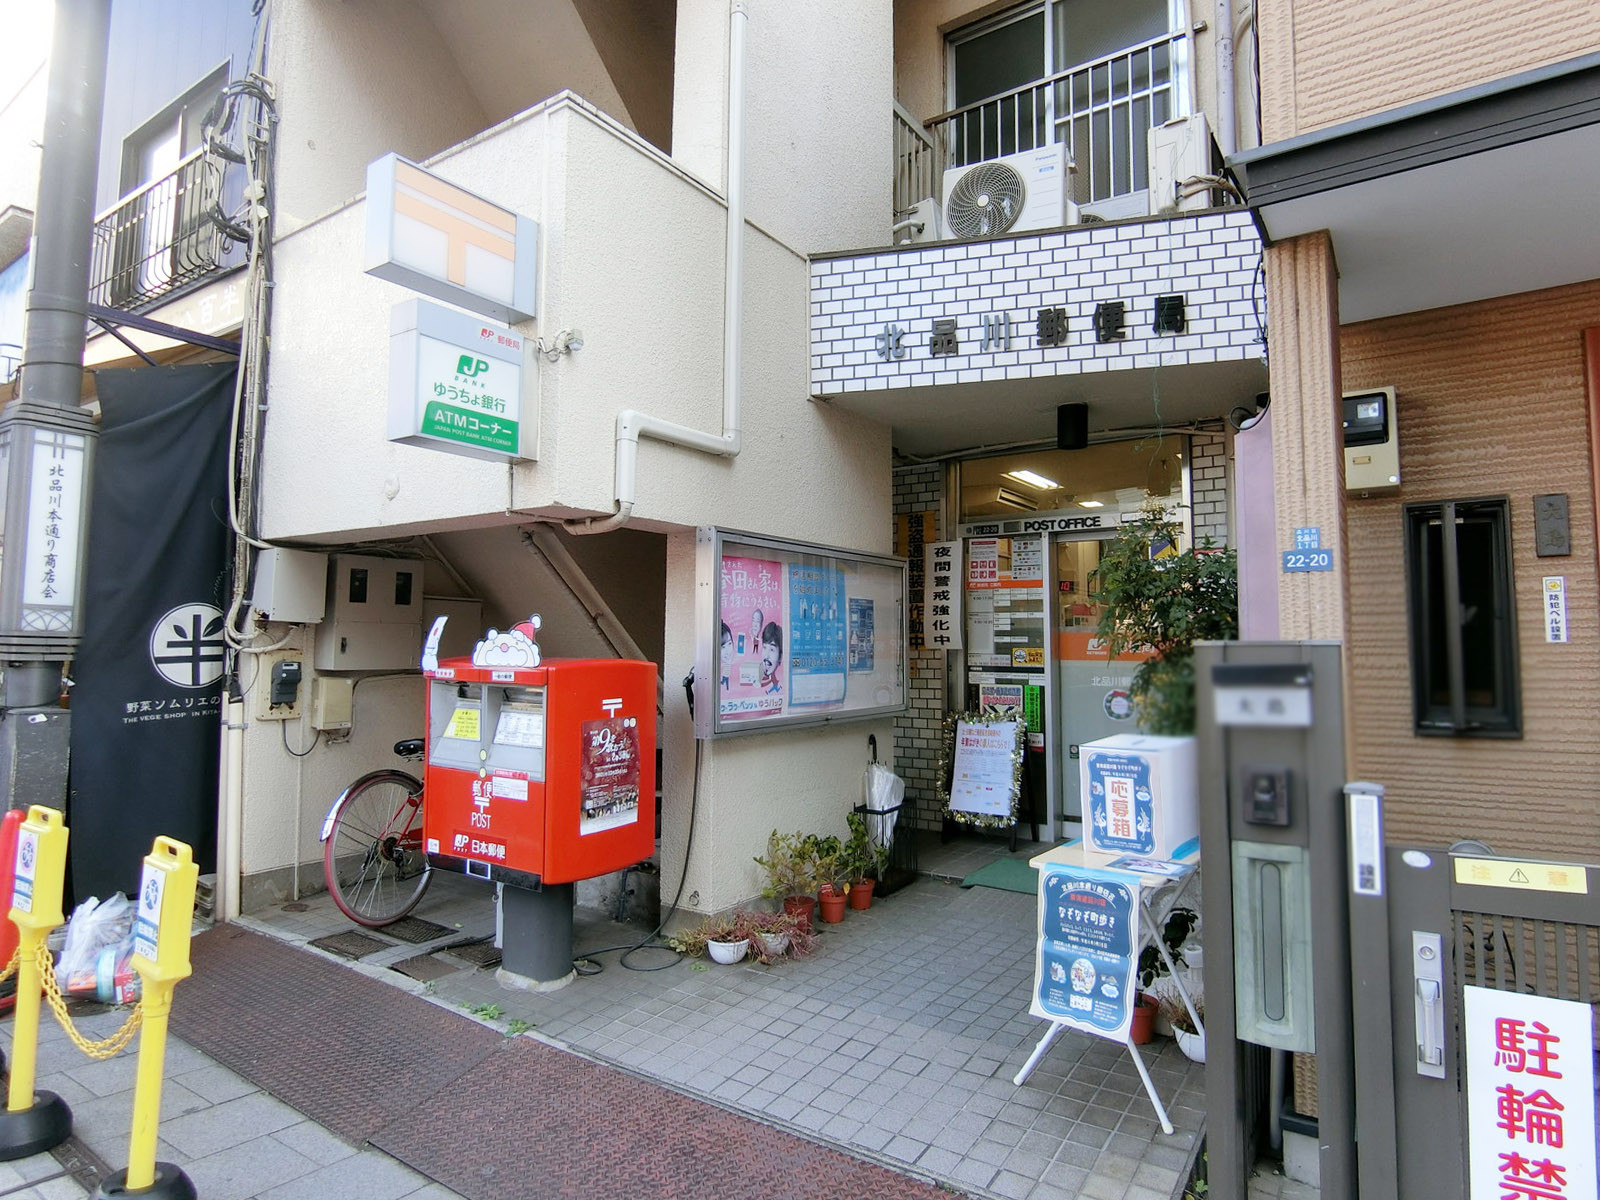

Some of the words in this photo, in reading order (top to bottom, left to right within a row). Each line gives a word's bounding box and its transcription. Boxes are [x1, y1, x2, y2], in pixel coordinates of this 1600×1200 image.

[876, 295, 1185, 361] 北品川郵便局
[497, 336, 520, 350] 郵便局
[454, 375, 486, 388] BANK
[434, 382, 506, 413] ゆうちょ銀行
[434, 409, 512, 434] ATMコーナー
[434, 425, 451, 433] JAPAN
[452, 428, 465, 437] POST
[466, 431, 480, 439] BANK
[41, 463, 65, 599] 北品川本通り商店会
[1024, 520, 1058, 532] POST
[1058, 516, 1101, 530] OFFICE
[1287, 553, 1328, 567] 22-20
[932, 546, 952, 646] 夜間警戒強化中
[1549, 594, 1561, 641] 防犯ベル設置
[472, 780, 494, 799] 郵便
[1111, 780, 1131, 837] 応募箱
[471, 812, 491, 829] POST
[471, 839, 506, 860] 日本郵便
[1058, 906, 1116, 928] なぞなぞ町歩き
[1495, 1017, 1568, 1200] 駐輪禁
